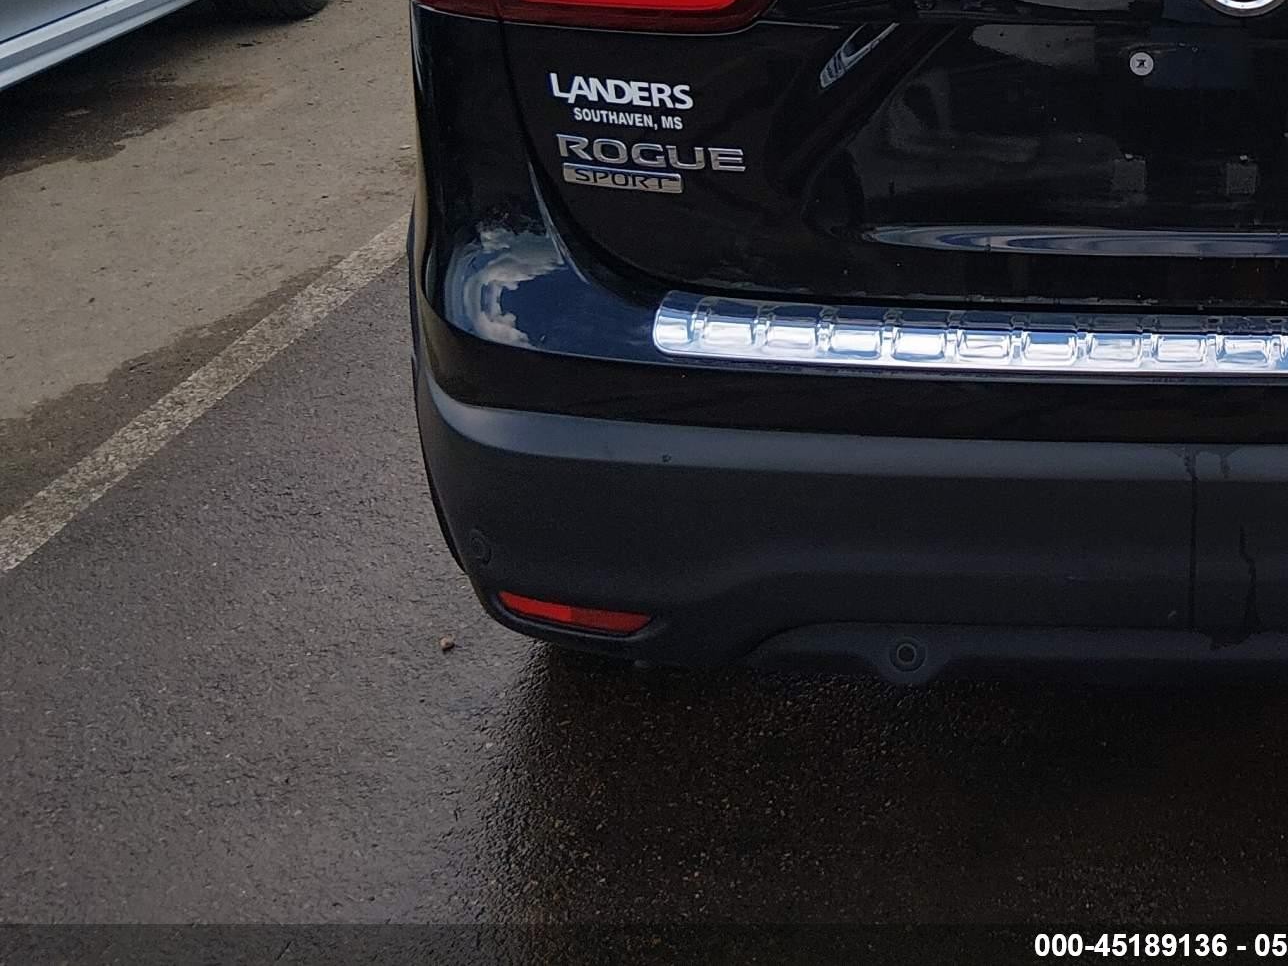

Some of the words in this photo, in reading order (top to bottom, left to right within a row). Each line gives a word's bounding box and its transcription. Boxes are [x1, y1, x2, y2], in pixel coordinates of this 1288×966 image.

[549, 72, 694, 110] LANDERS
[574, 107, 658, 130] SOUTHAVEN,
[661, 115, 683, 130] MS
[555, 133, 747, 172] ROGUE
[575, 168, 671, 190] SPORT
